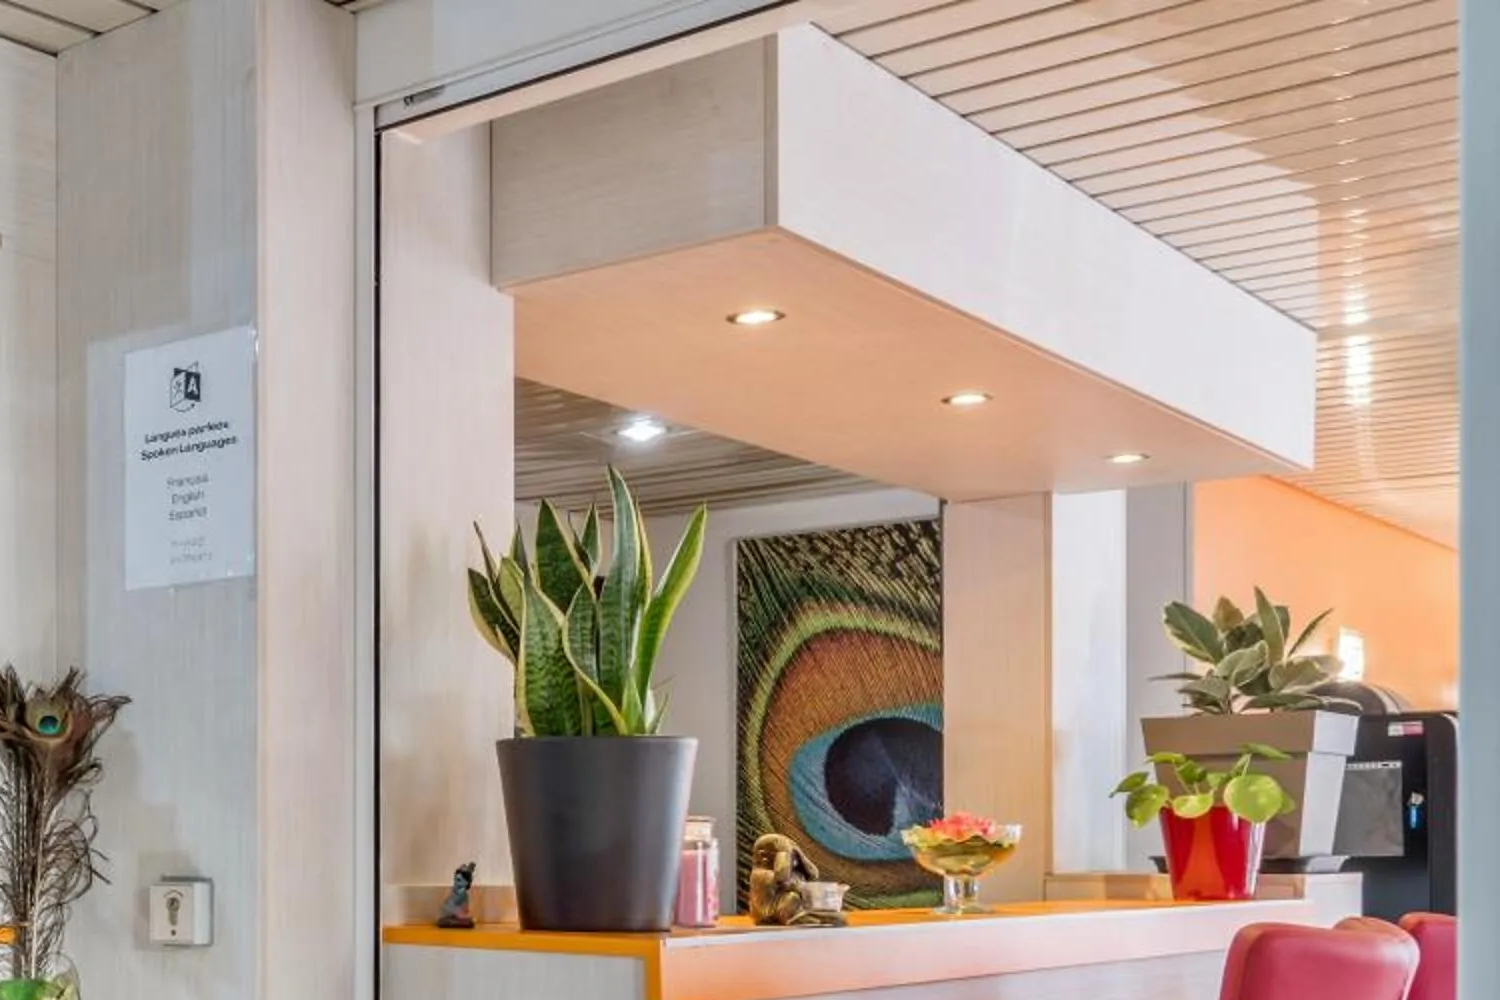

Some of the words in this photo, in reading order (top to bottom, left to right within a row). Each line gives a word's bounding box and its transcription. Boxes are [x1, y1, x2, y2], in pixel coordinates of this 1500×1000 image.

[144, 427, 187, 444] Langues
[140, 447, 178, 461] Spoken
[179, 435, 238, 453] Languages
